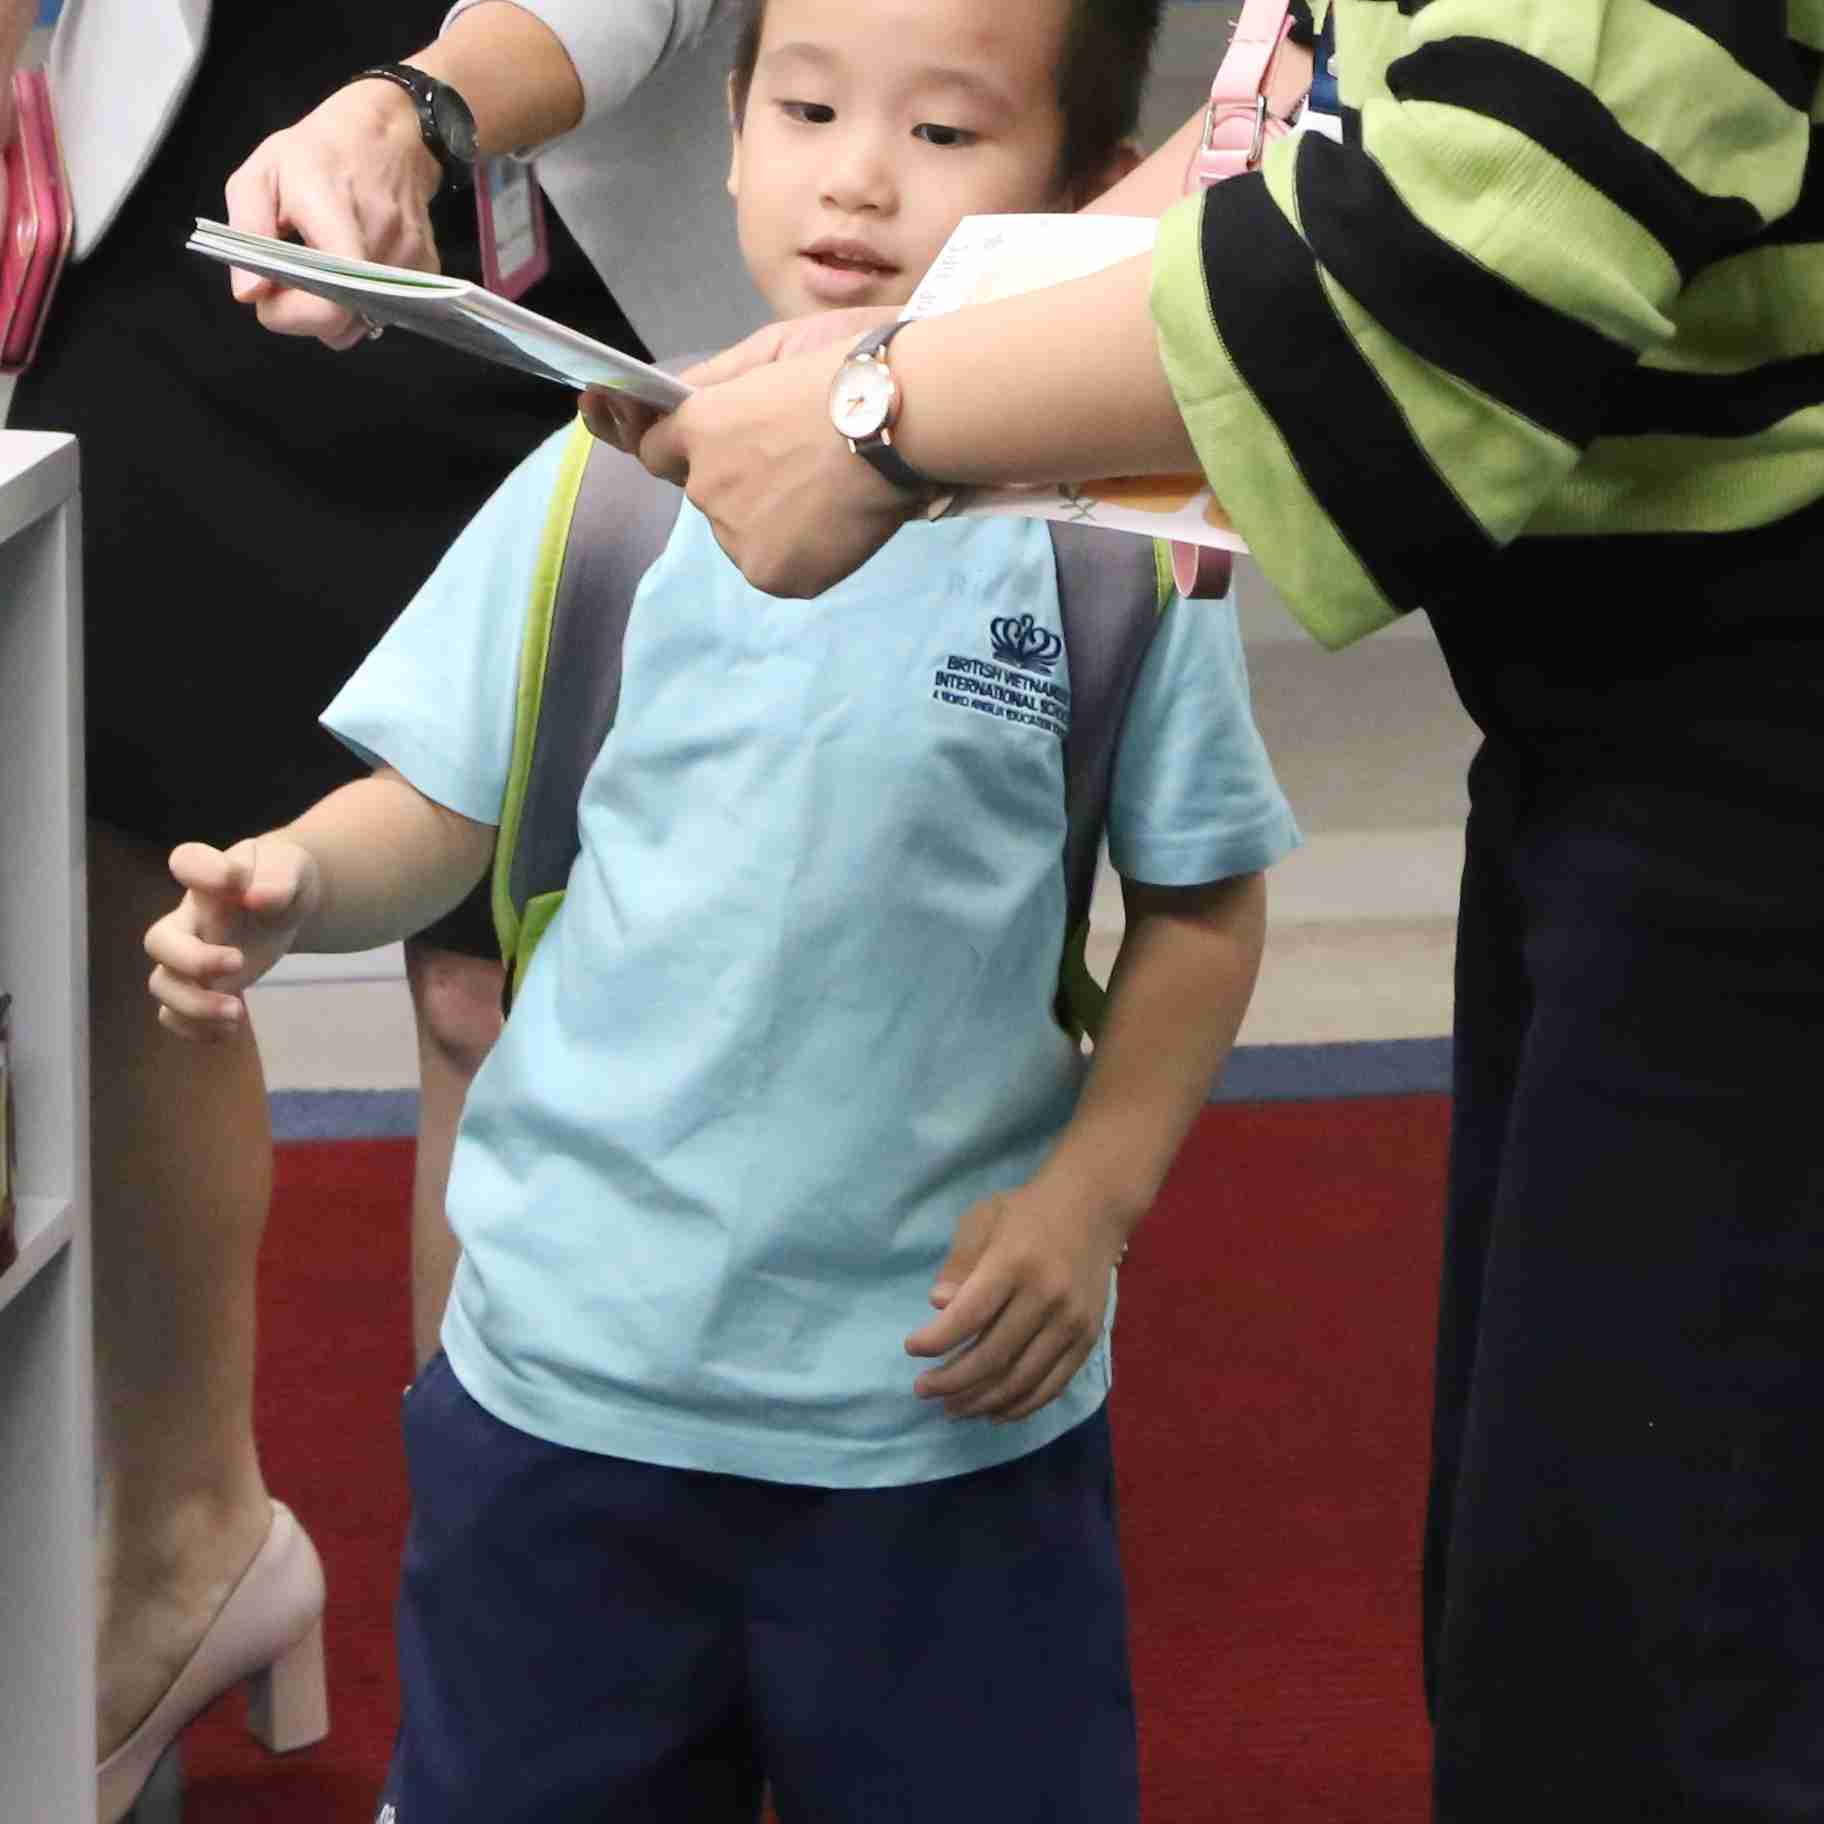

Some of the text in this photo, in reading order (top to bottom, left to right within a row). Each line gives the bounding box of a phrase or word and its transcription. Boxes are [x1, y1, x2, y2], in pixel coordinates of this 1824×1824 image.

[934, 670, 1040, 712] INTERNATIONAL
[946, 655, 1071, 712] BRITISH VIETNA
